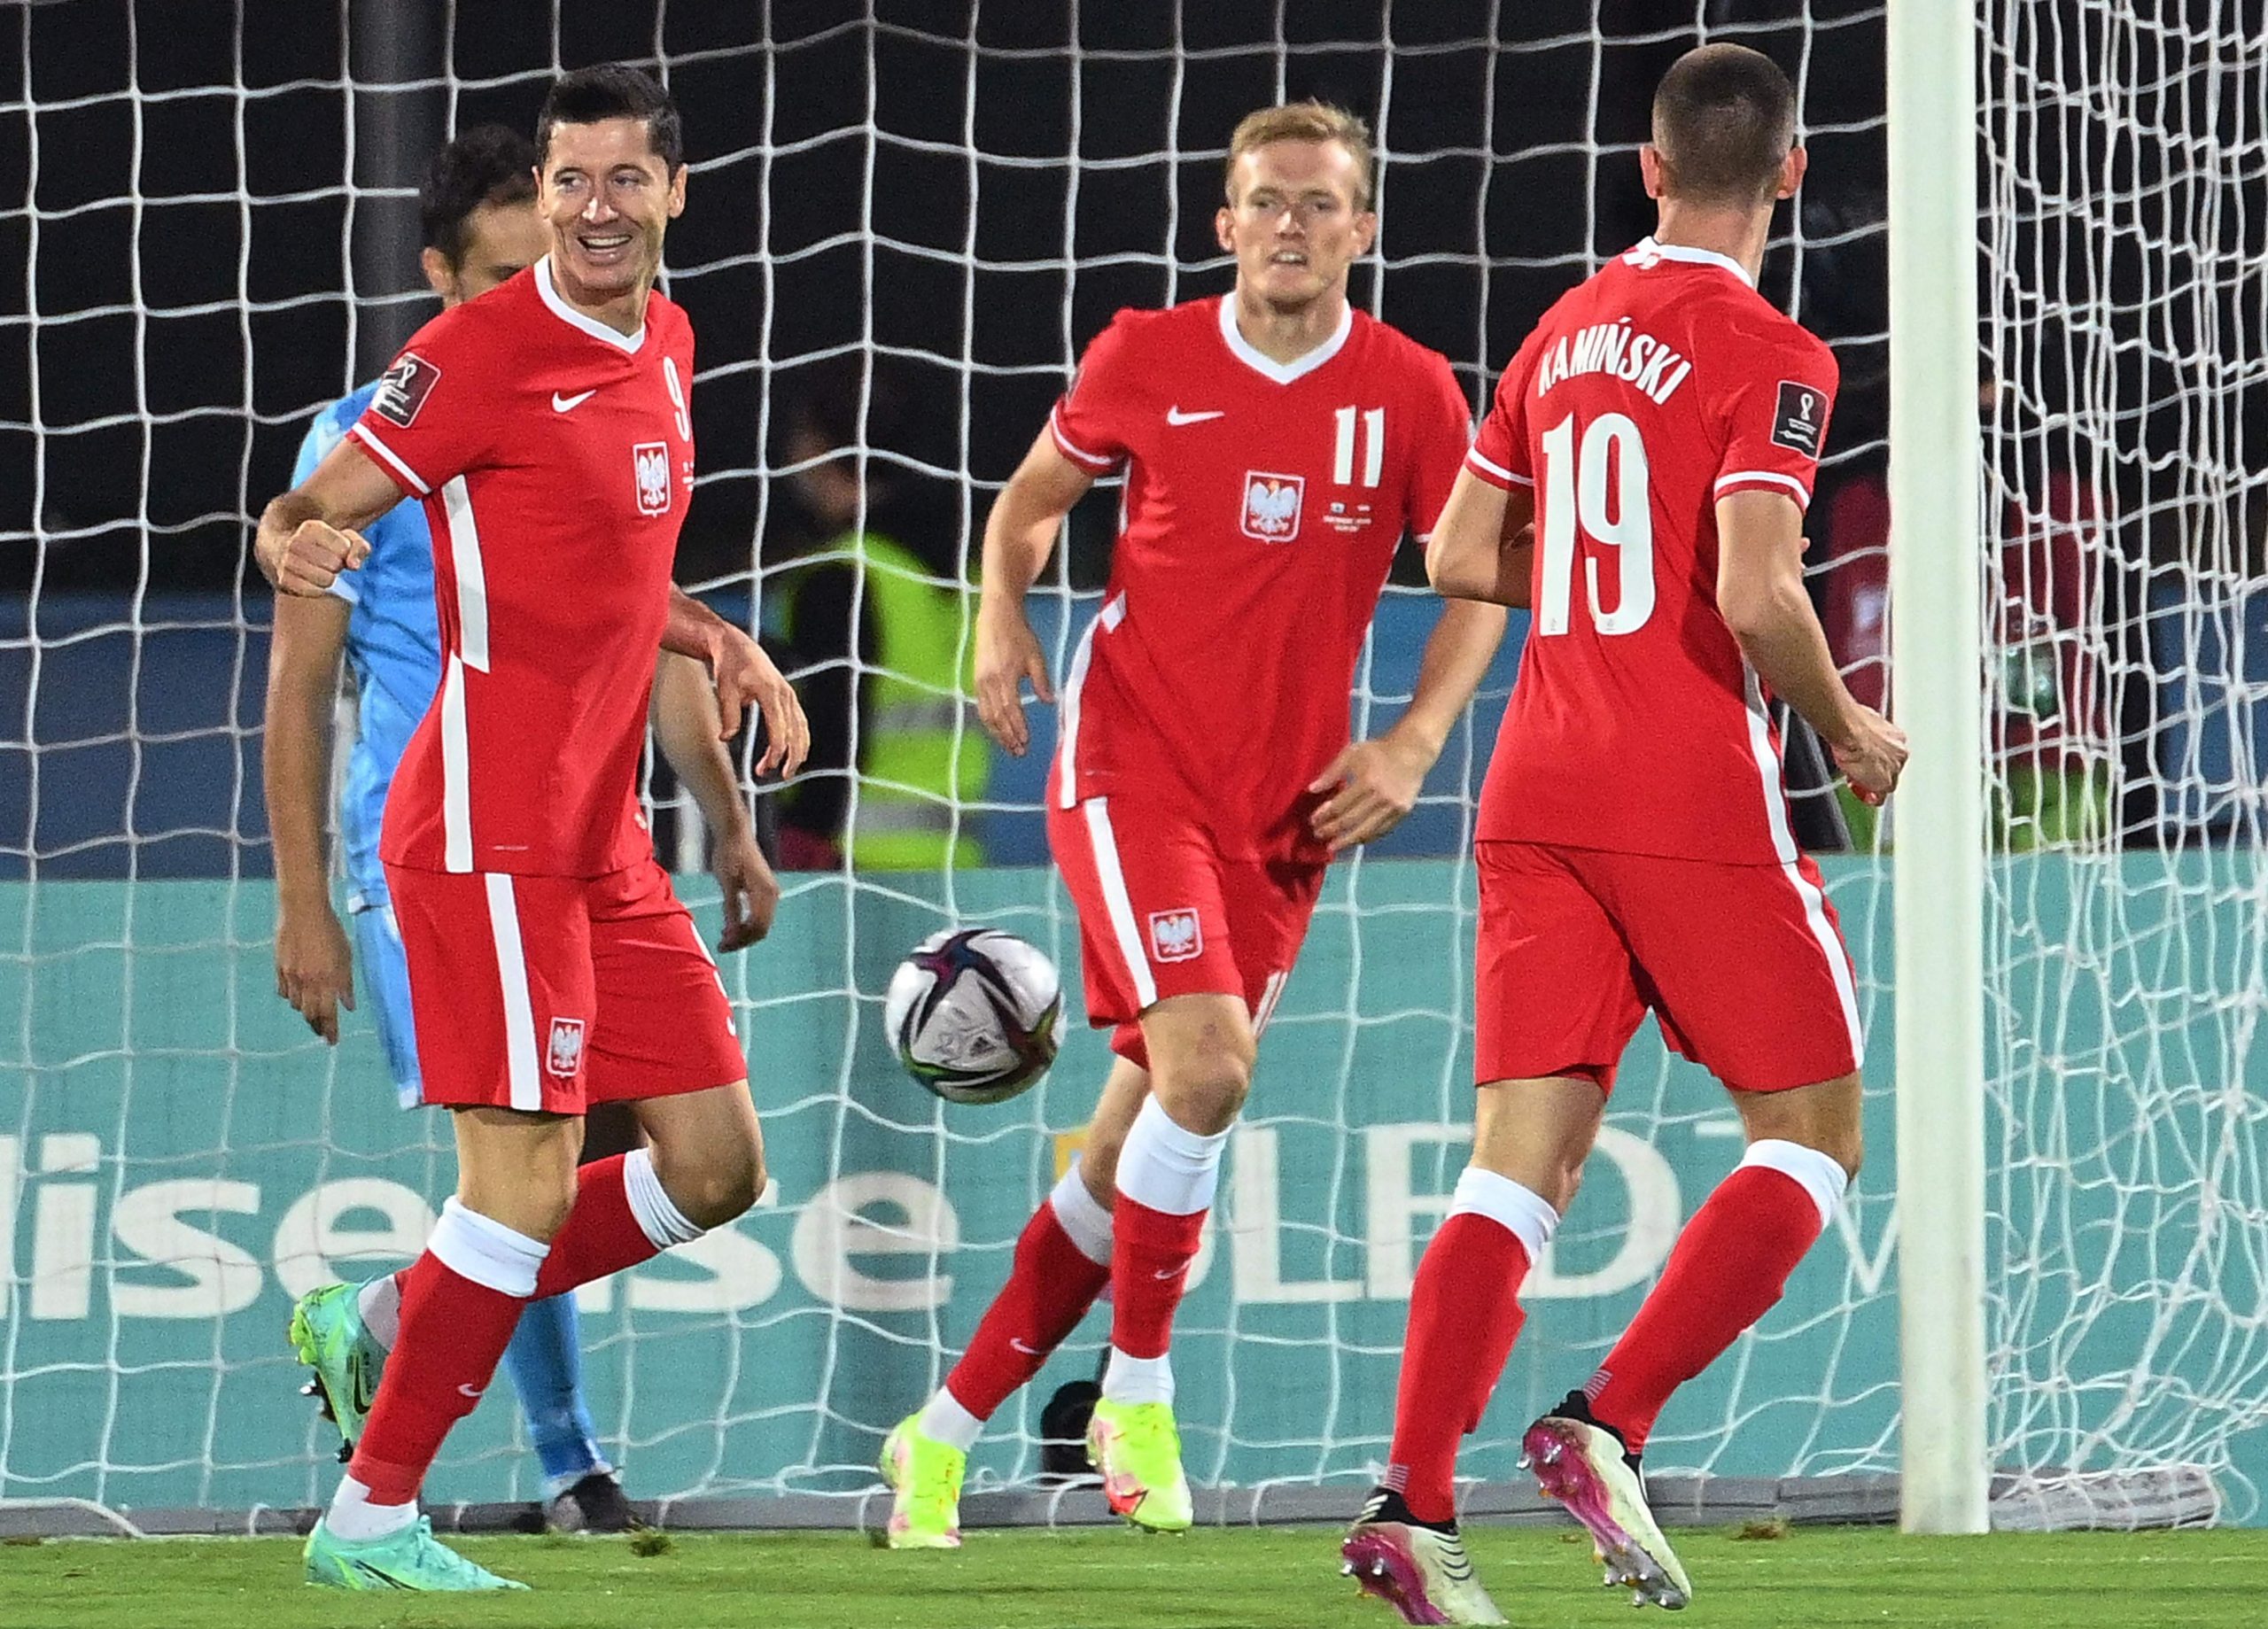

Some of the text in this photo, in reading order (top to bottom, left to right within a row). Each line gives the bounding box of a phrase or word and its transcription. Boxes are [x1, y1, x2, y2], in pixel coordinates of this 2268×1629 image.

[663, 356, 690, 443] 9
[1538, 316, 1692, 405] KAMIŃSKI
[1333, 404, 1385, 488] 11
[1539, 411, 1656, 636] 19
